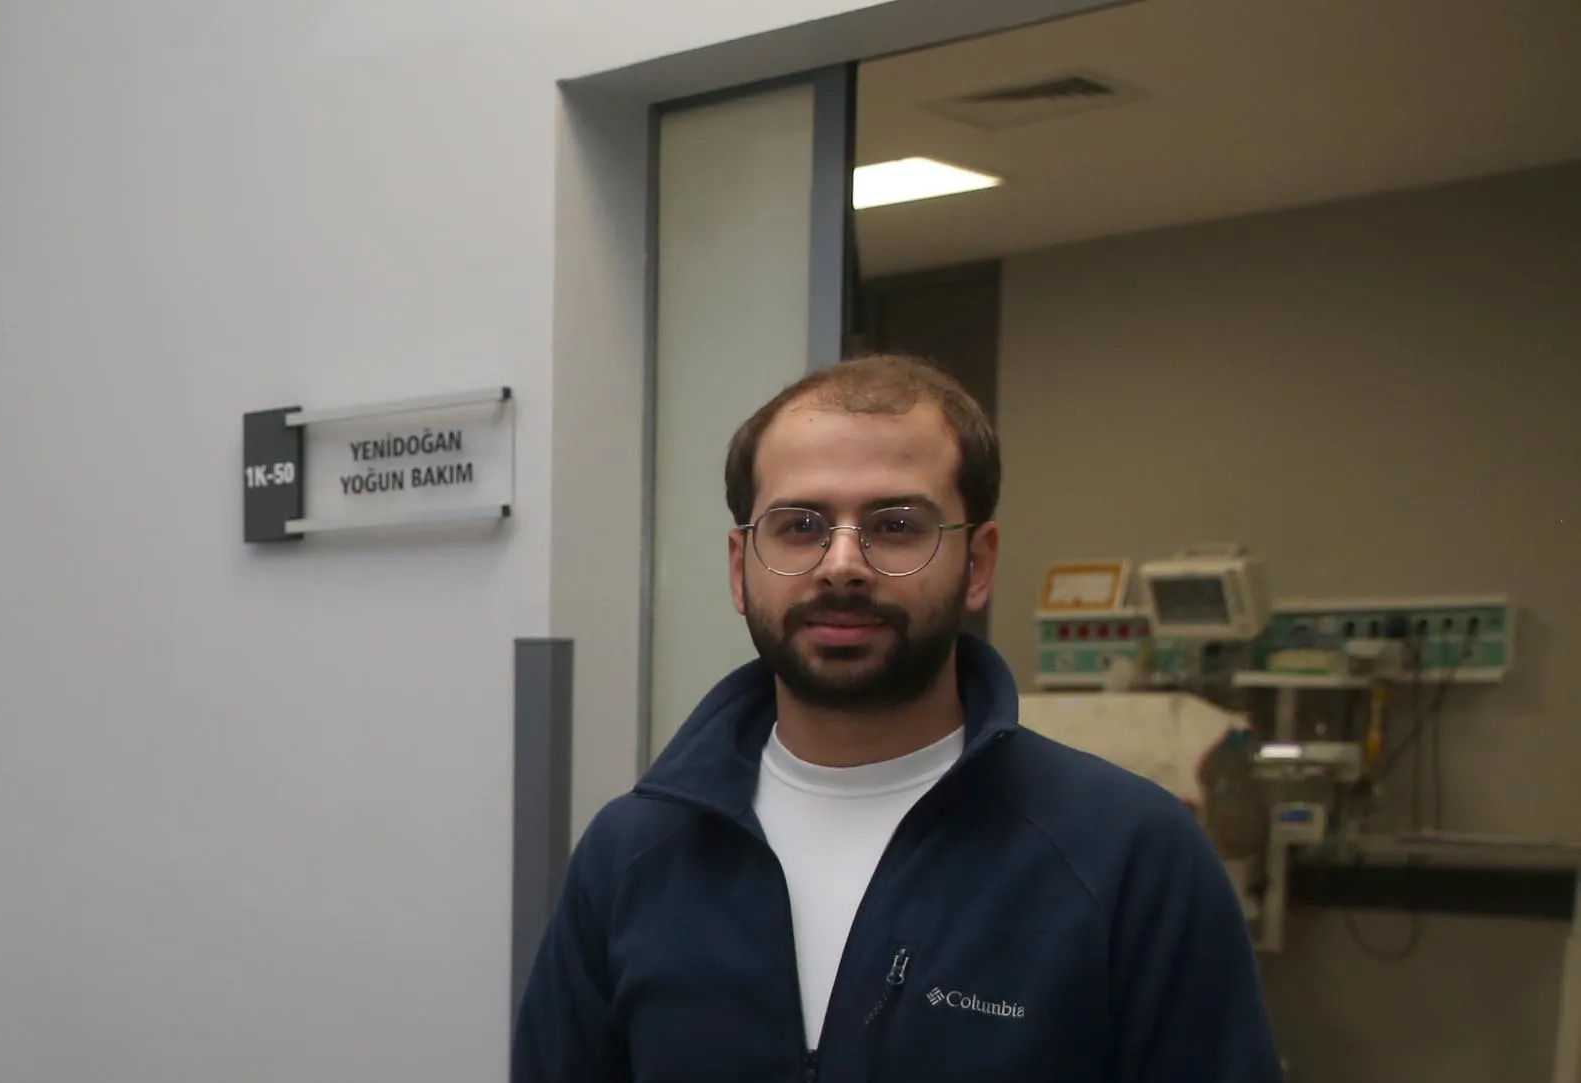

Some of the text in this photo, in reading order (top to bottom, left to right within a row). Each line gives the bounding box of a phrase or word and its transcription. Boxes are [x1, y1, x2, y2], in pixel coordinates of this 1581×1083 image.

[349, 428, 462, 461] YENİDOĞAN
[245, 462, 295, 488] 1K-50
[340, 462, 474, 495] YOĞUN BAKIM
[945, 990, 1025, 1018] Columbia
